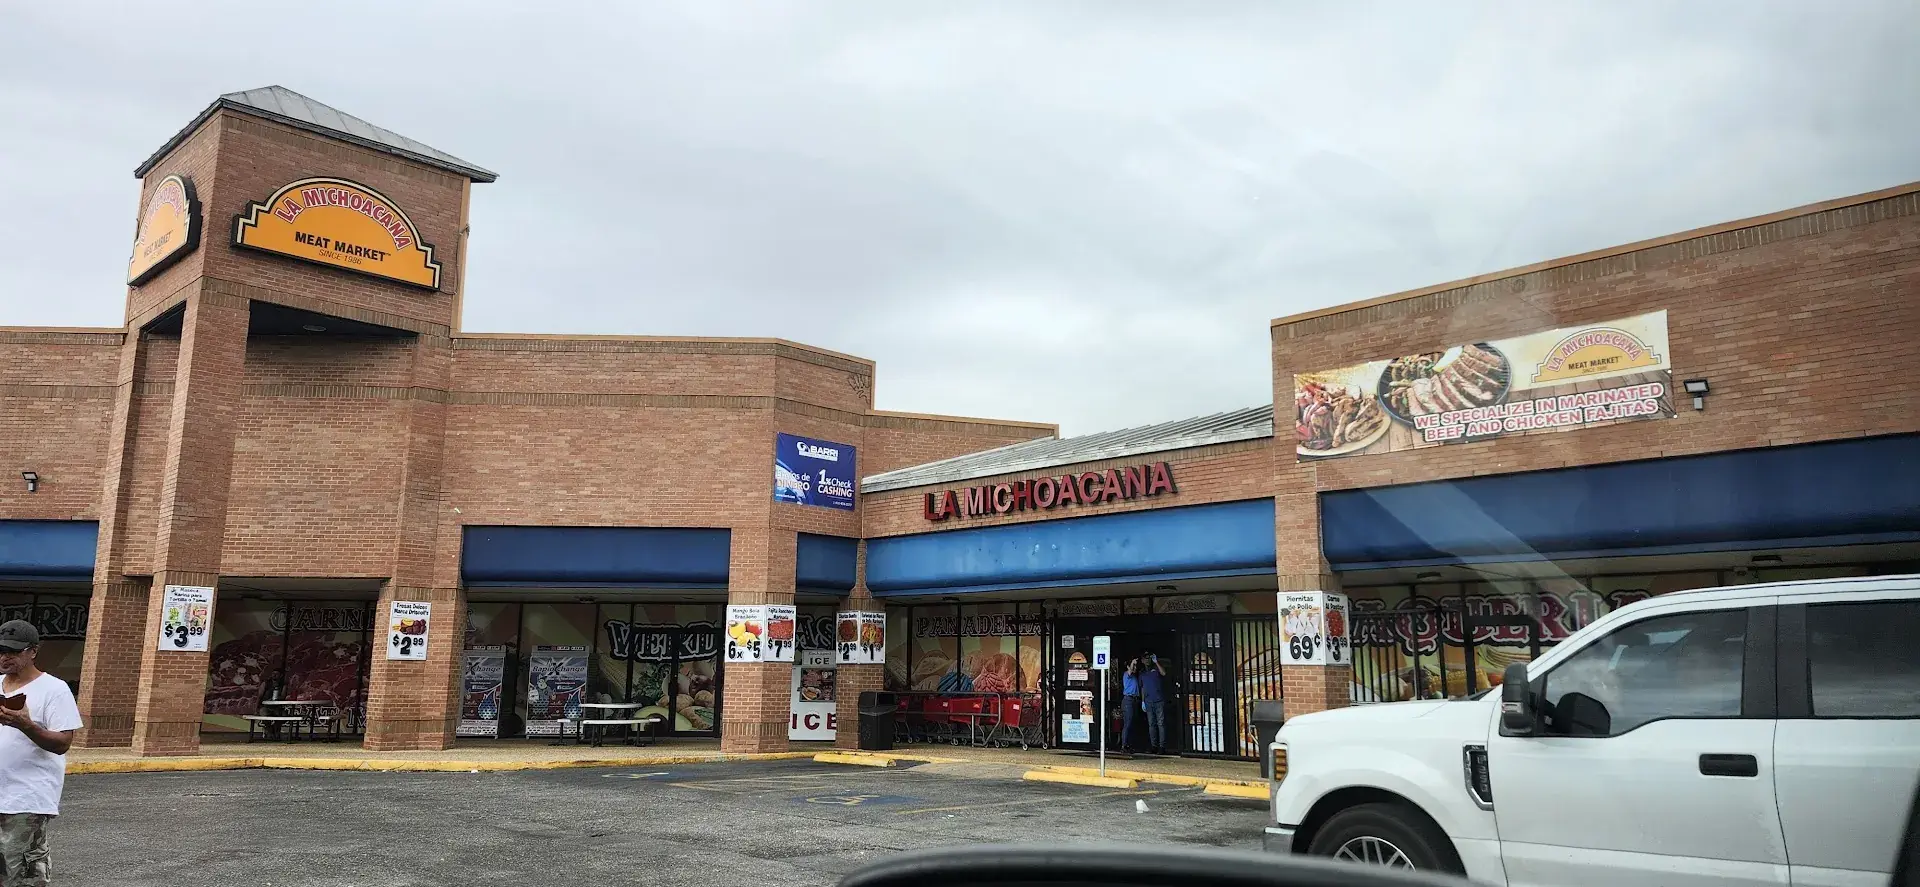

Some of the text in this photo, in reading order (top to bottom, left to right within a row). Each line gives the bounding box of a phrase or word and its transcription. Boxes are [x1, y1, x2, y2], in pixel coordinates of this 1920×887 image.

[275, 187, 412, 250] LA MICHOACANA
[295, 231, 386, 261] MEAT MARKET
[319, 249, 362, 264] SINCE 1986
[1547, 333, 1642, 371] LA MICHOACANA
[1568, 357, 1619, 370] MEAT MARKET
[1415, 384, 1663, 429] WE SPECIALIZE IN MARINATED
[1426, 400, 1657, 440] BEEF AND CHICKEN FAJITAS
[810, 446, 838, 457] BARRI
[776, 479, 810, 490] DINERO
[801, 473, 810, 481] de
[831, 477, 852, 488] Check
[818, 485, 852, 497] CASHING
[924, 462, 1178, 520] LA MICHOACANA
[916, 608, 1049, 637] PANADERIA
[747, 639, 761, 658] $5
[1290, 632, 1321, 660] 69¢
[810, 657, 829, 665] ICE
[792, 712, 837, 730] ICE
